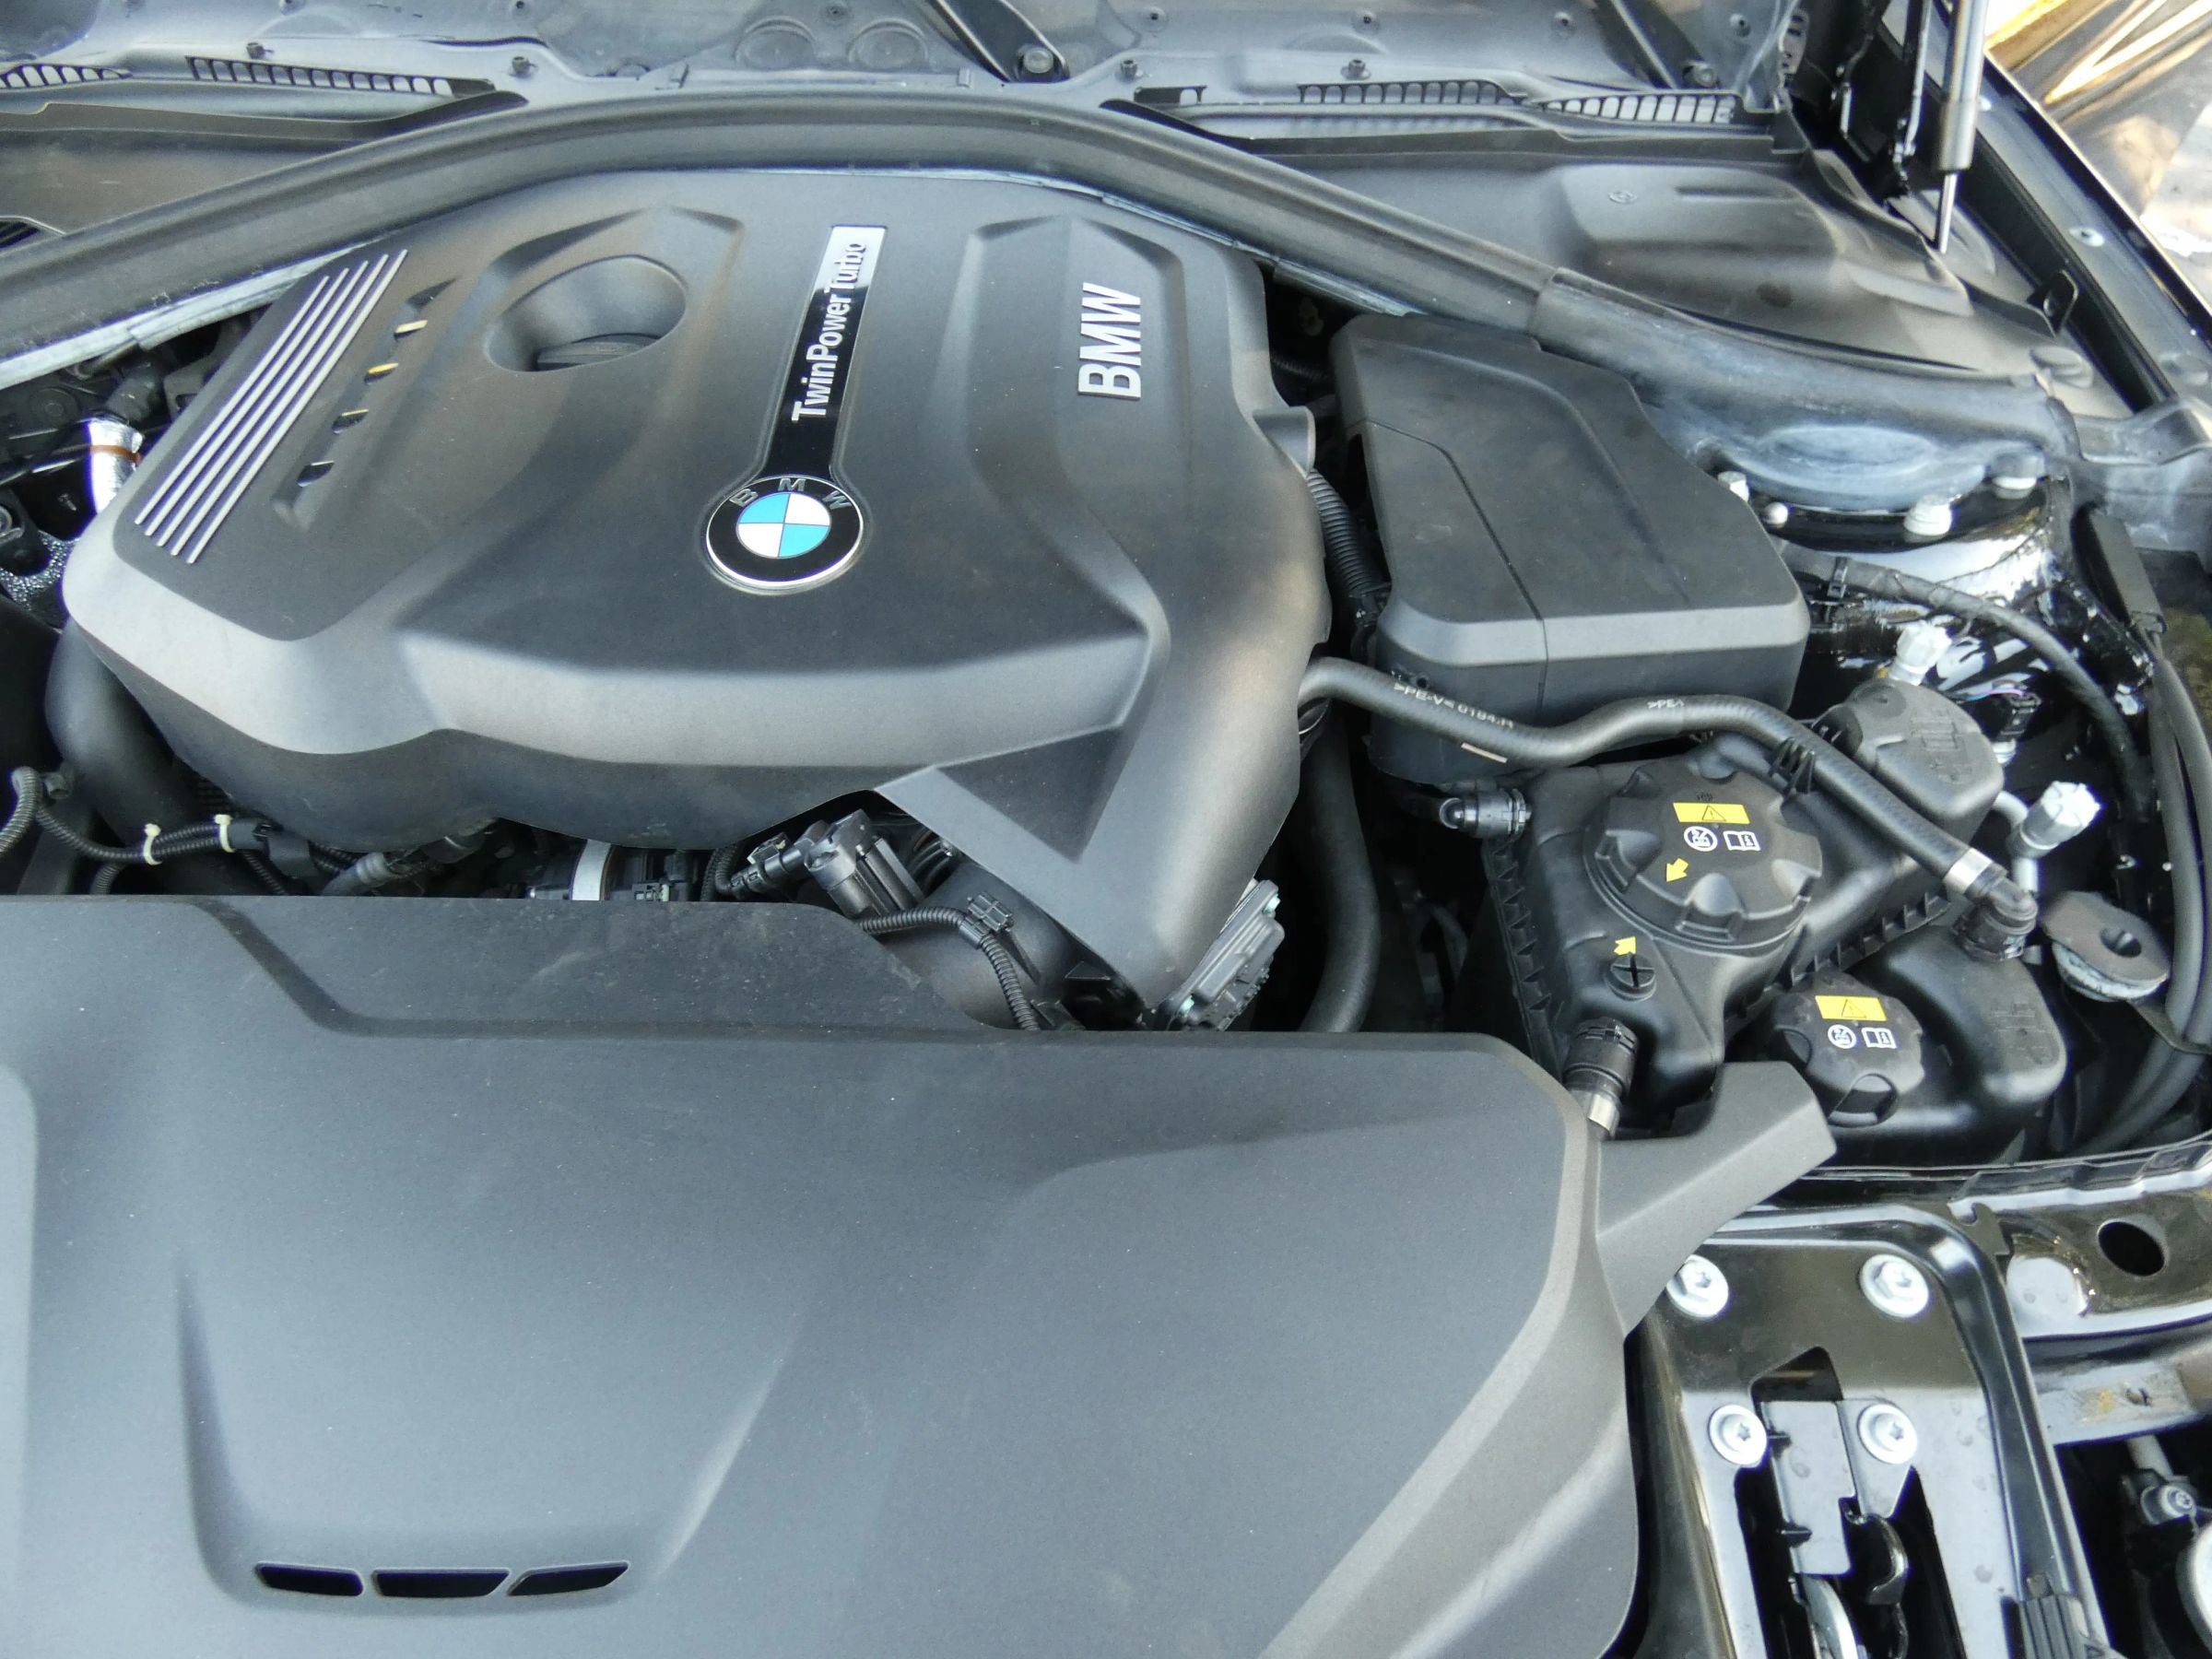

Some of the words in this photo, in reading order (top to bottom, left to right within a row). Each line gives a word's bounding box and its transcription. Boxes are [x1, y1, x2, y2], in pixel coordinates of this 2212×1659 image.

[791, 293, 852, 422] TwinPower
[824, 242, 866, 294] Turbo
[1077, 281, 1142, 399] BMW
[729, 477, 853, 511] BMW
